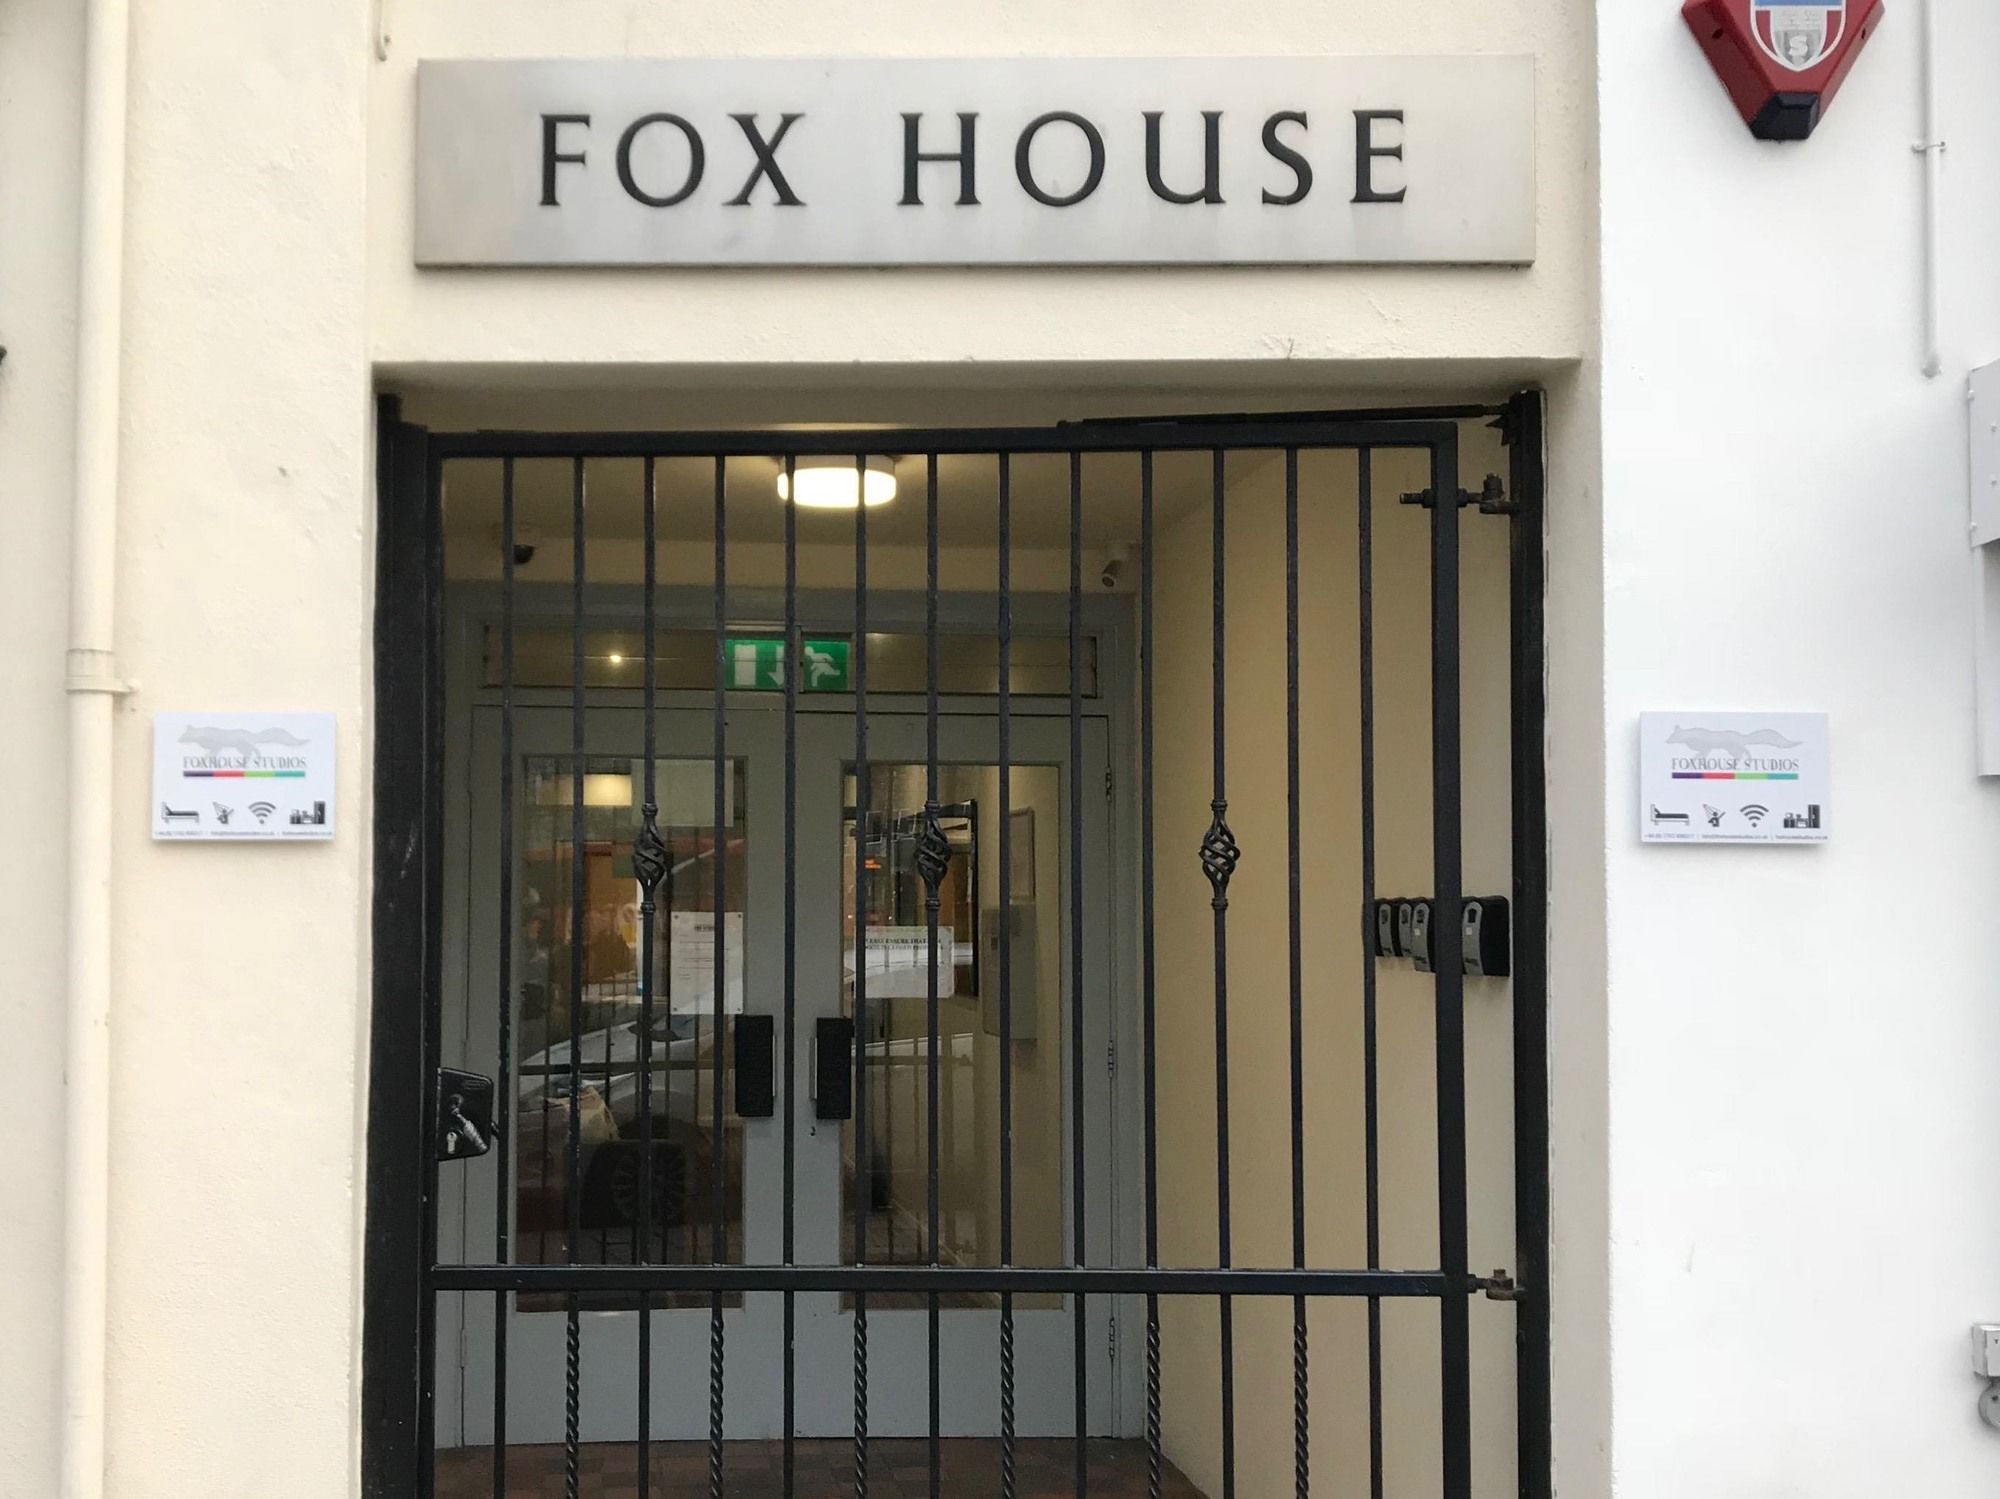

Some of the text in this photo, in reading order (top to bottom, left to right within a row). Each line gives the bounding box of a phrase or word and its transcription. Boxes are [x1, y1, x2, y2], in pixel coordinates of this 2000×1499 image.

[540, 110, 1406, 207] FOX HOUSE
[183, 756, 306, 769] FOXHOUSE STUDIOS
[1672, 758, 1799, 771] FOXHOUSE STUDIOS
